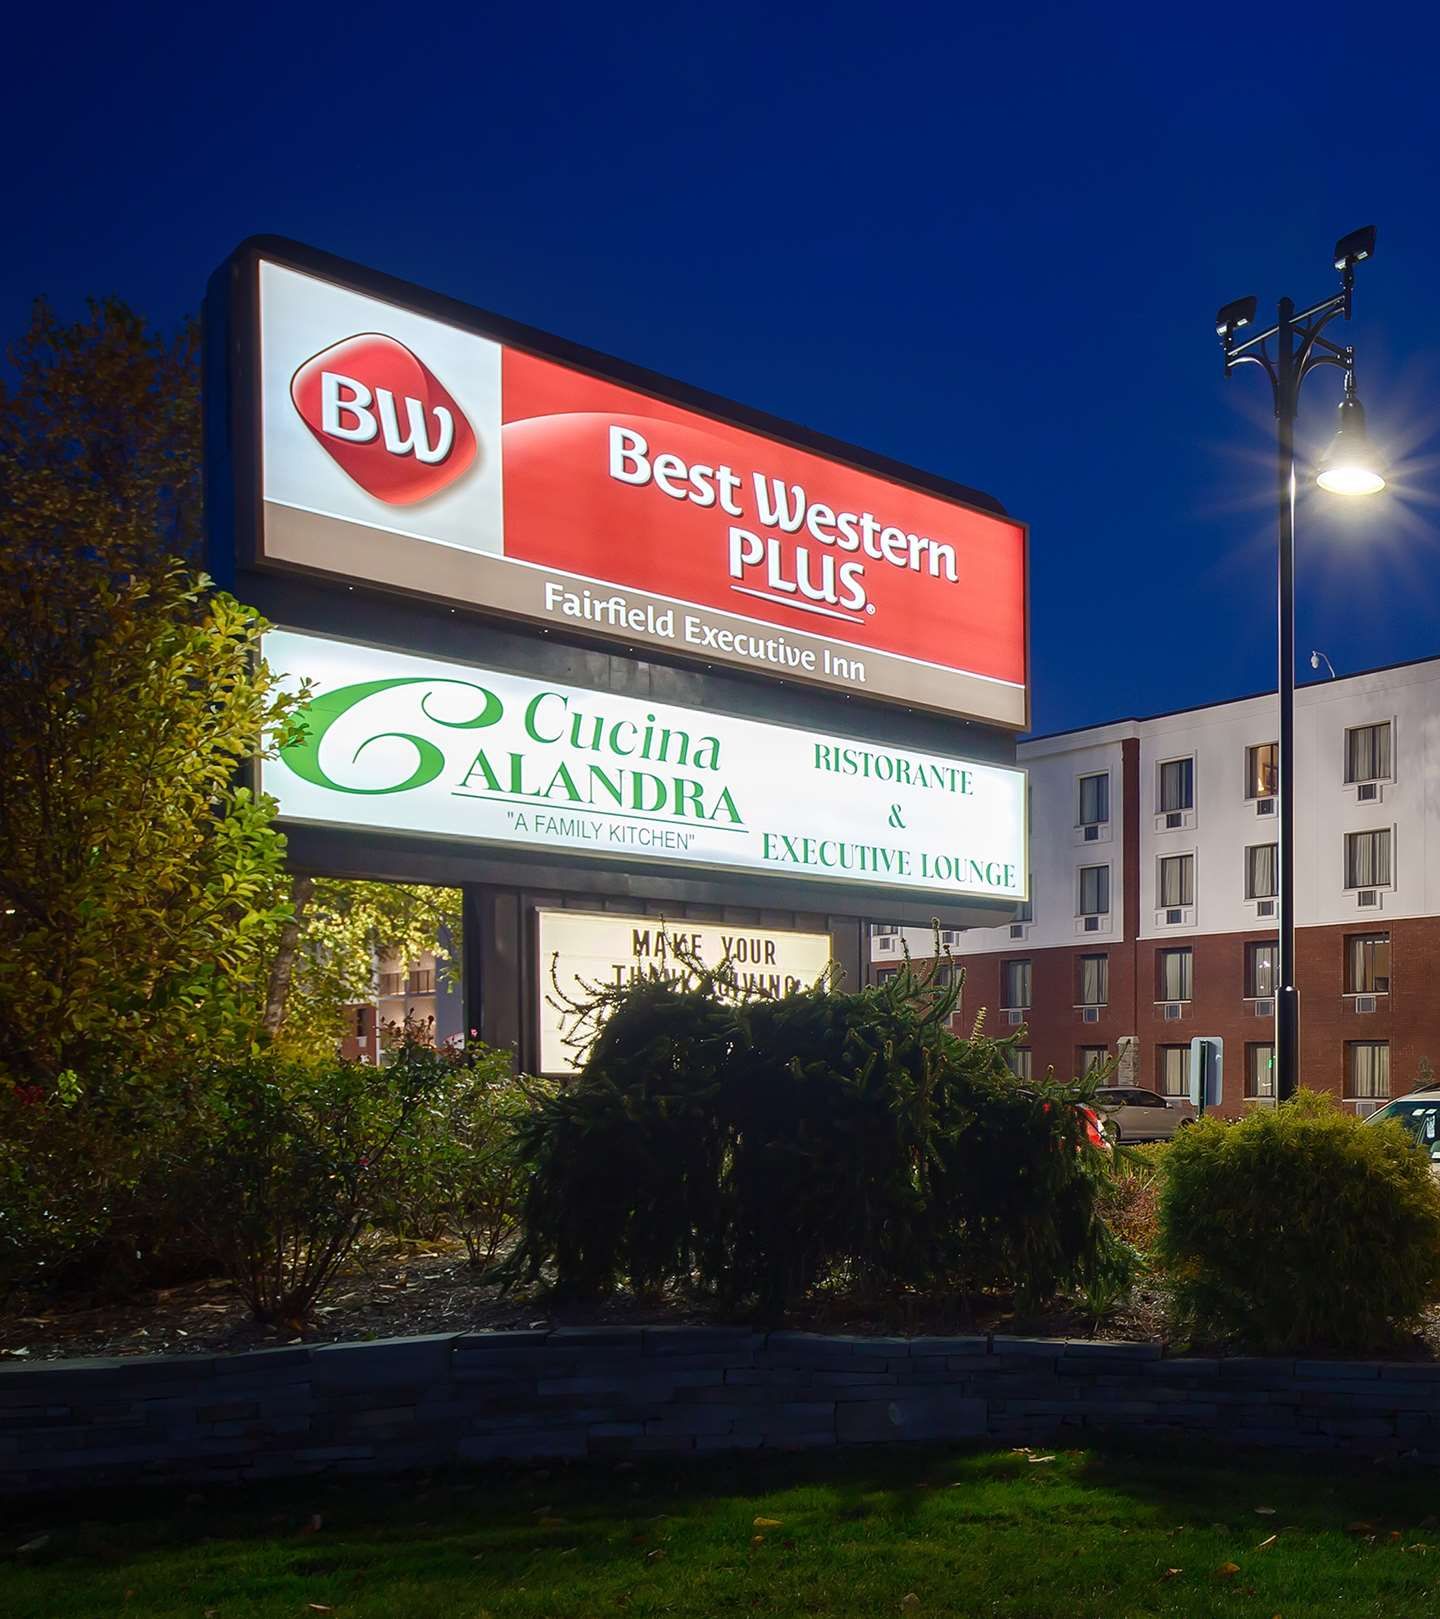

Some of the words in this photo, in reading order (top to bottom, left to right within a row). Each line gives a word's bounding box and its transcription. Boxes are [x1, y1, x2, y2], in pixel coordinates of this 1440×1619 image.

[320, 370, 455, 464] BW
[608, 424, 744, 517] Best
[751, 471, 961, 583] Western
[544, 581, 675, 638] Fairfield
[684, 615, 816, 671] Executive
[823, 649, 866, 682] Inn
[524, 691, 721, 771] Cucina
[813, 743, 974, 796] RISTORANTE
[534, 814, 603, 841] FAMILY
[888, 803, 907, 829] &
[762, 832, 912, 876] EXECUTIVE
[920, 853, 1016, 888] LOUNGE
[632, 928, 703, 961] MAKE
[720, 935, 776, 966] YOUR
